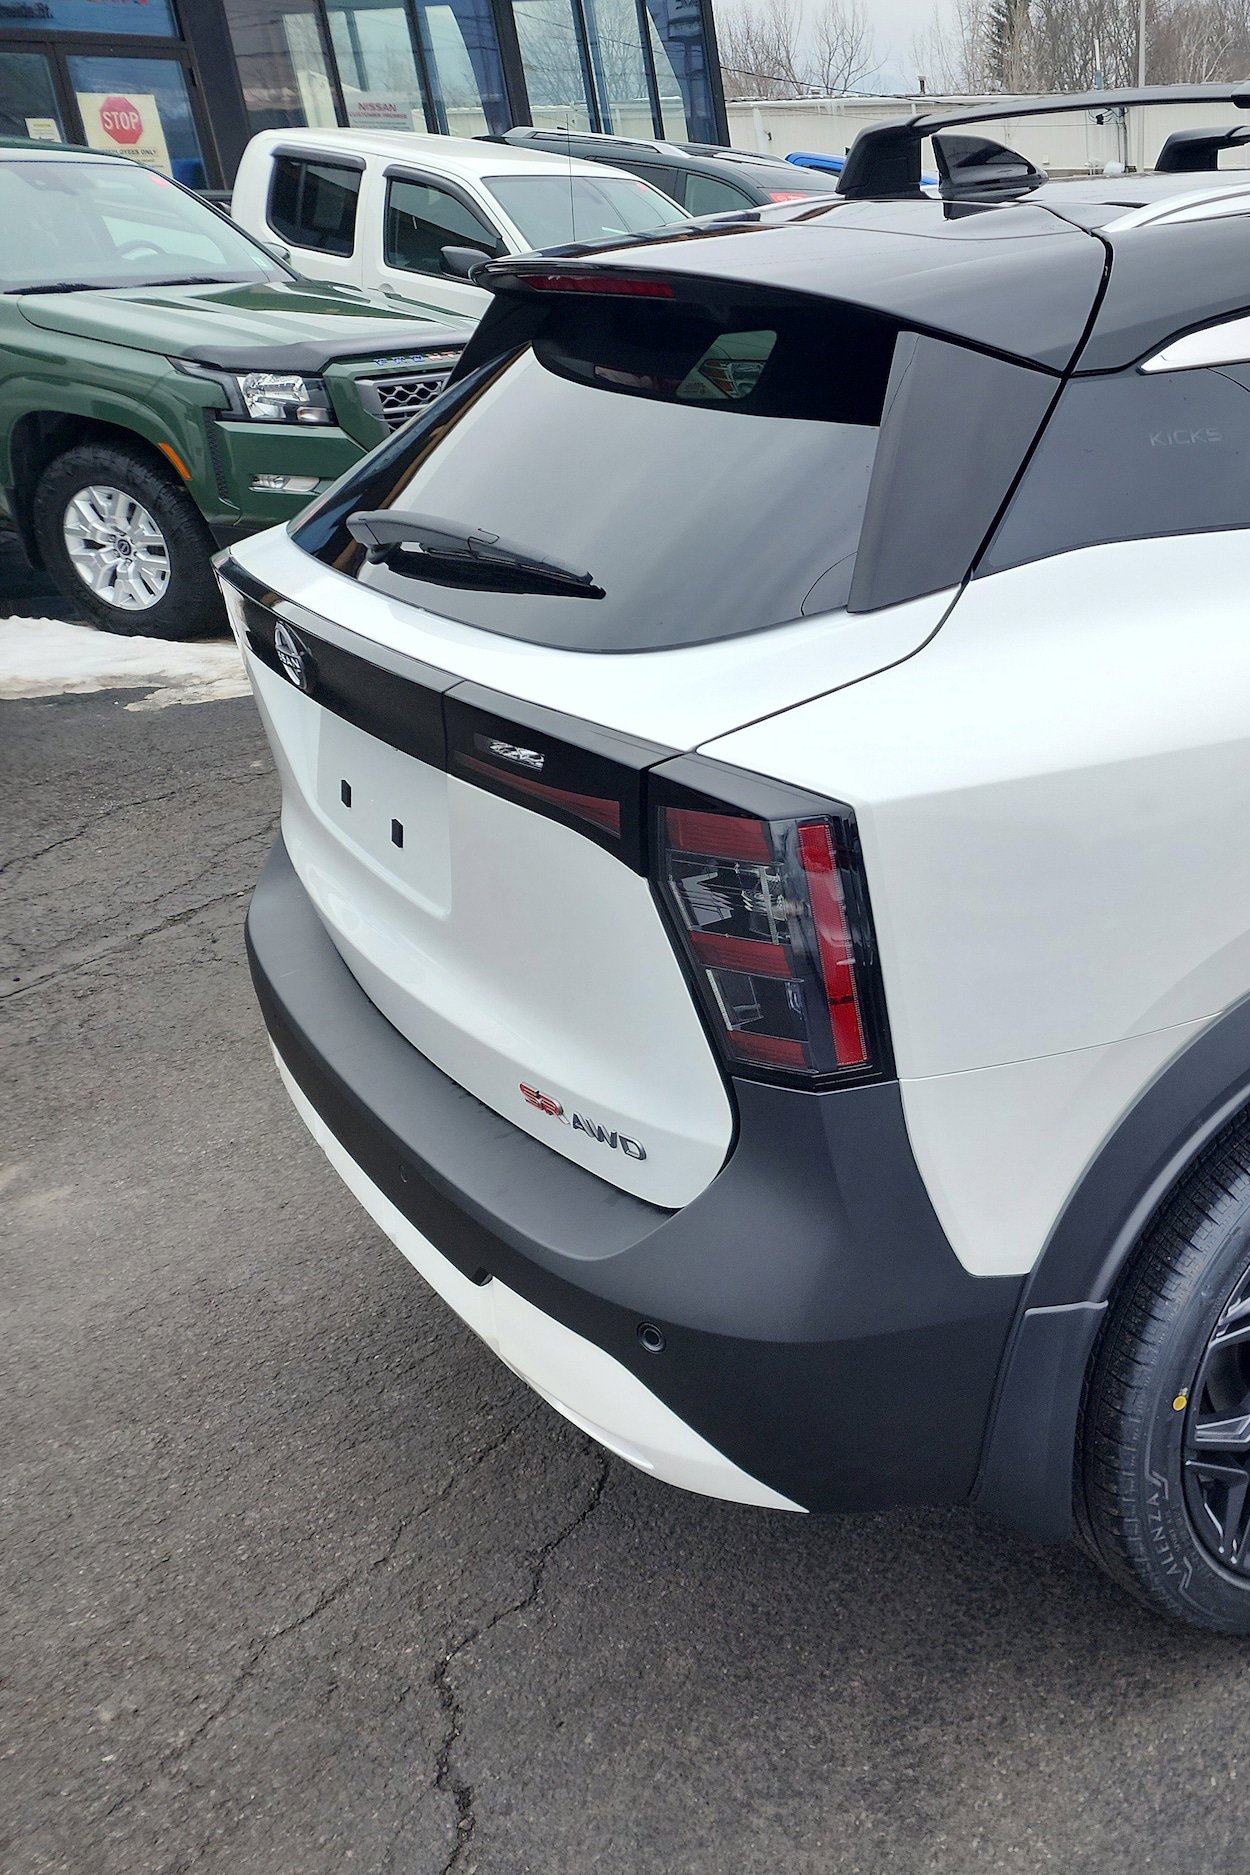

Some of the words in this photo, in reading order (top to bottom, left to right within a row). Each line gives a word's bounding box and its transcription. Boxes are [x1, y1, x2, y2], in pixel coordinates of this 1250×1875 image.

[358, 102, 397, 112] NISSAN
[103, 111, 139, 130] STOP
[1149, 426, 1223, 447] KICKS
[519, 1081, 570, 1125] SR
[572, 1111, 647, 1161] AWD
[1146, 1492, 1181, 1576] ALENZA
